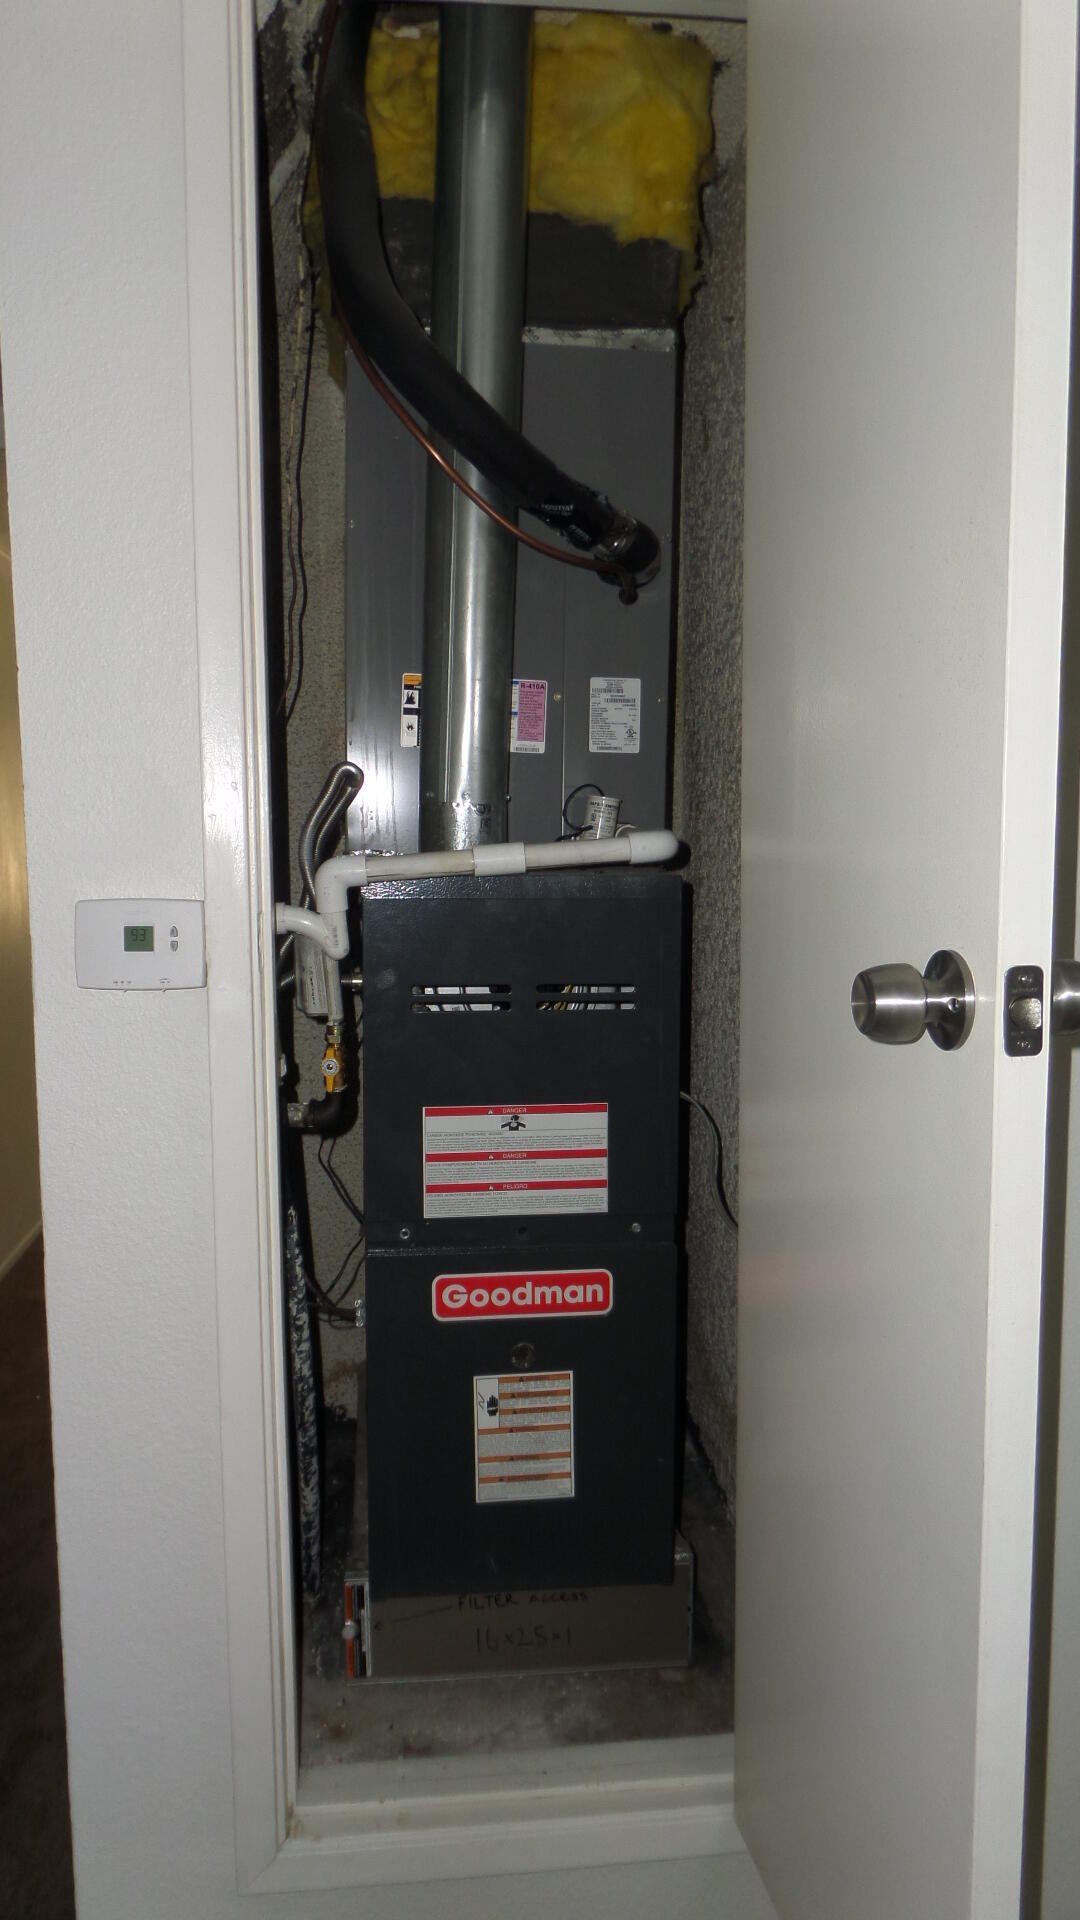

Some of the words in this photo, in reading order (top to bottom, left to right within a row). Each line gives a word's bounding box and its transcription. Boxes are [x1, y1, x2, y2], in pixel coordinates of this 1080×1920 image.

[520, 682, 545, 690] R-410A
[502, 1106, 527, 1114] DANGER
[442, 1281, 603, 1308] Goodman
[458, 1593, 520, 1612] FILTER
